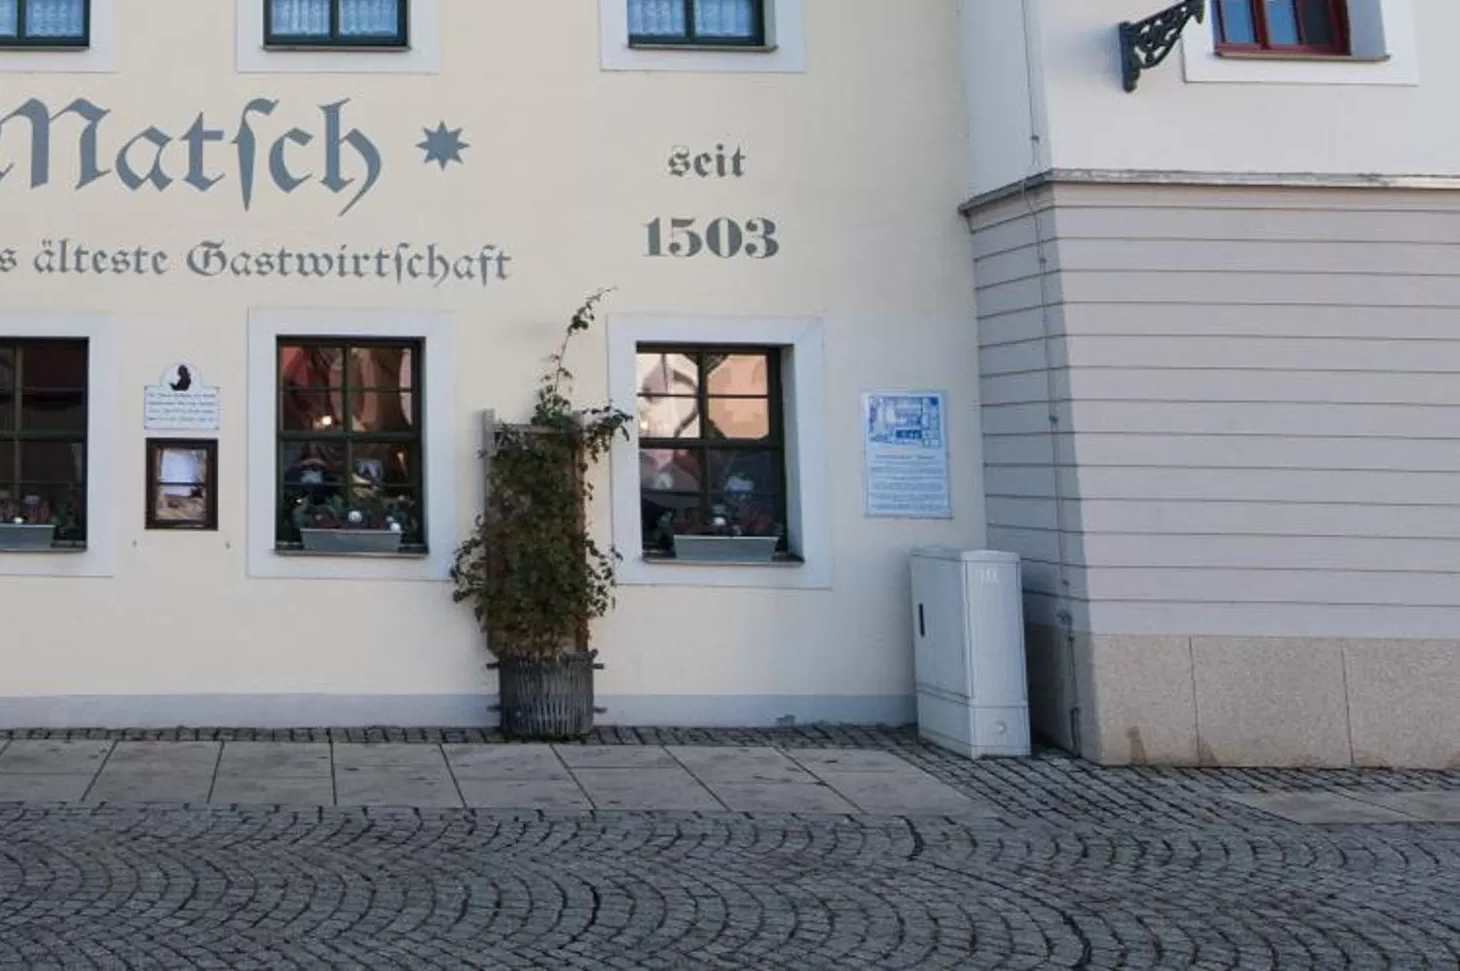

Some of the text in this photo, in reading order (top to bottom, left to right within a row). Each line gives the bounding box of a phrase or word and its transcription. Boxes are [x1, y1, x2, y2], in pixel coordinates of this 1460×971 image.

[668, 143, 746, 178] seit
[642, 216, 780, 259] 1503
[34, 238, 168, 276] älteste
